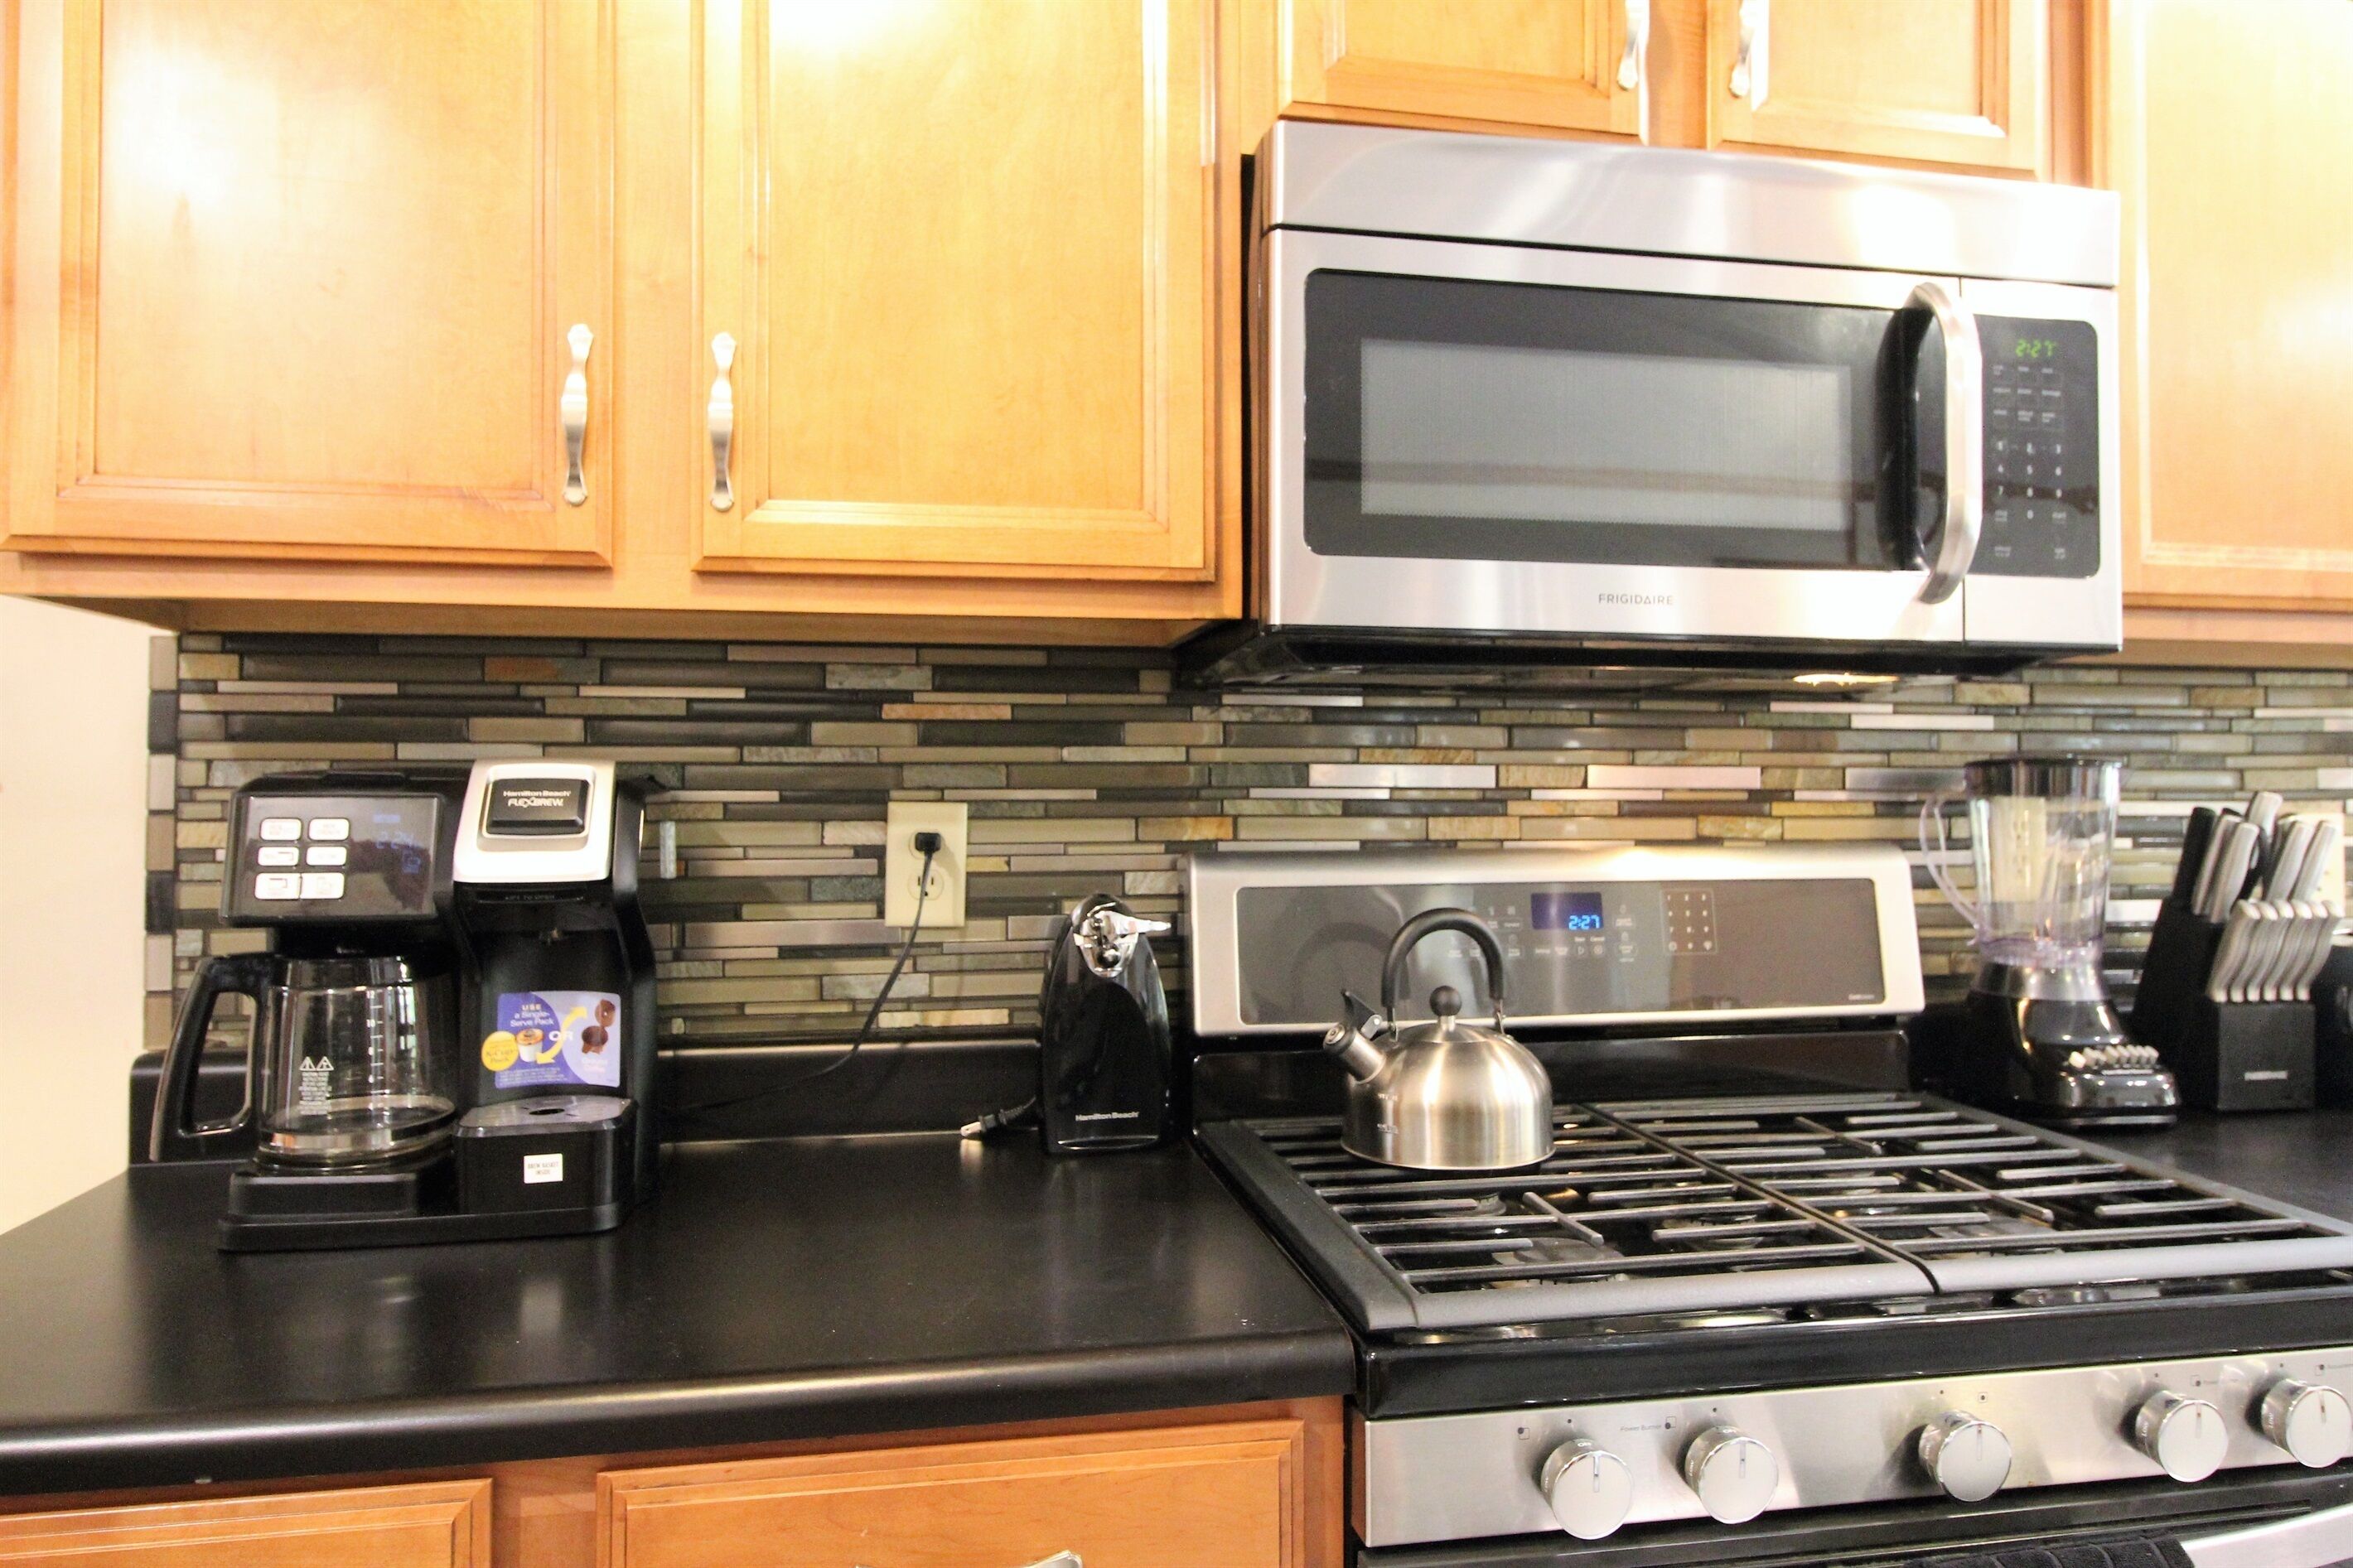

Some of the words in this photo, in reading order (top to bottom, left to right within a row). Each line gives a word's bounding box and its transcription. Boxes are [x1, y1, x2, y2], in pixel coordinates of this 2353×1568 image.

[2015, 339, 2054, 358] 2:27
[1598, 593, 1674, 605] FRIGIDAIRE
[1568, 914, 1601, 930] 2:27
[510, 1019, 534, 1027] Serve
[534, 1017, 554, 1025] Pack
[548, 1030, 573, 1042] OR
